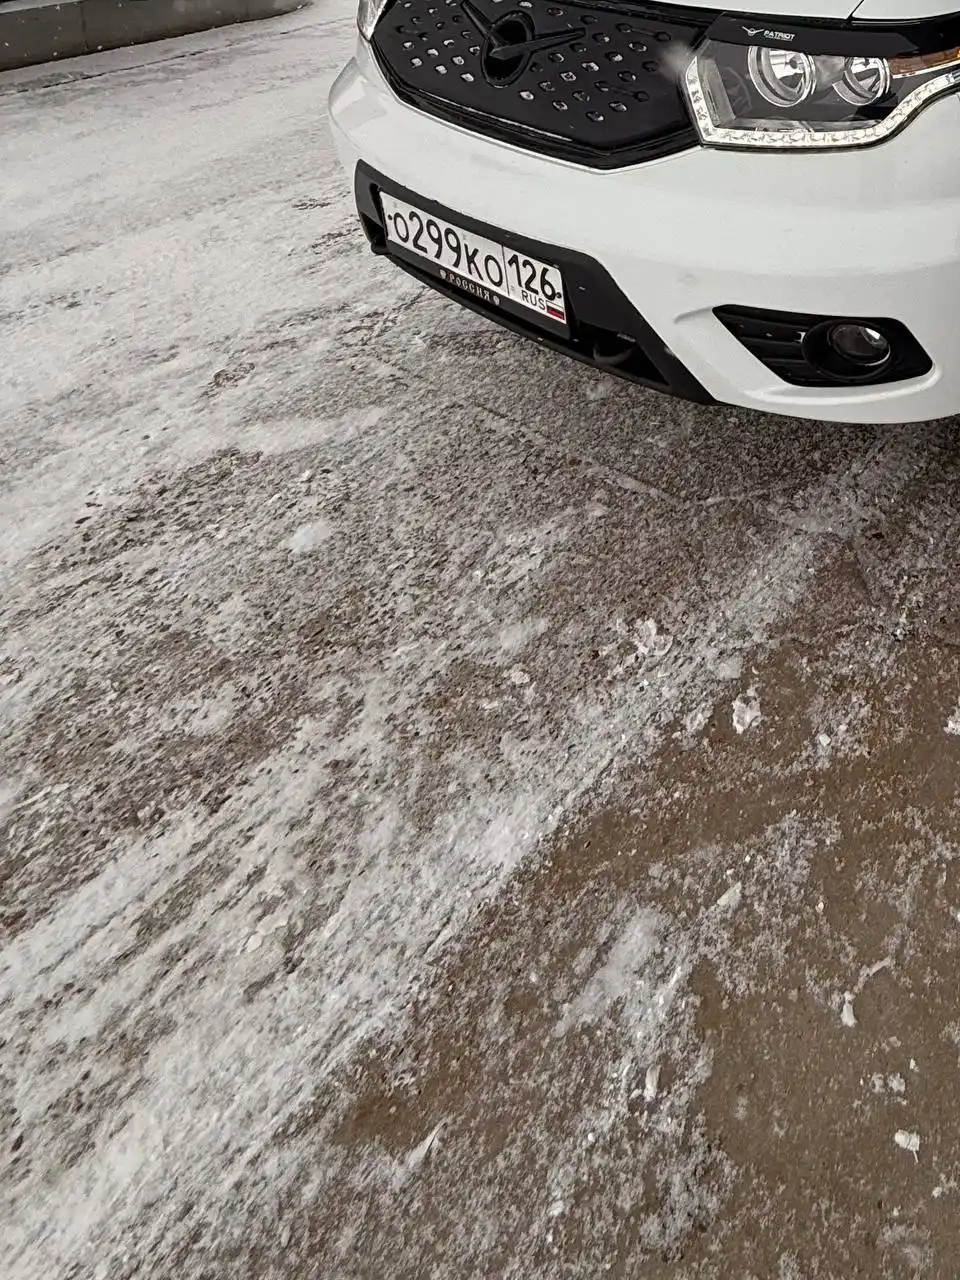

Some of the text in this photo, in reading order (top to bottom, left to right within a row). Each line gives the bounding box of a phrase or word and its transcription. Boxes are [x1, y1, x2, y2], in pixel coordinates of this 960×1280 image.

[763, 30, 796, 41] PATRIOT
[449, 273, 491, 301] РОССИЯ
[507, 253, 556, 301] 126
[521, 289, 546, 310] RUS
